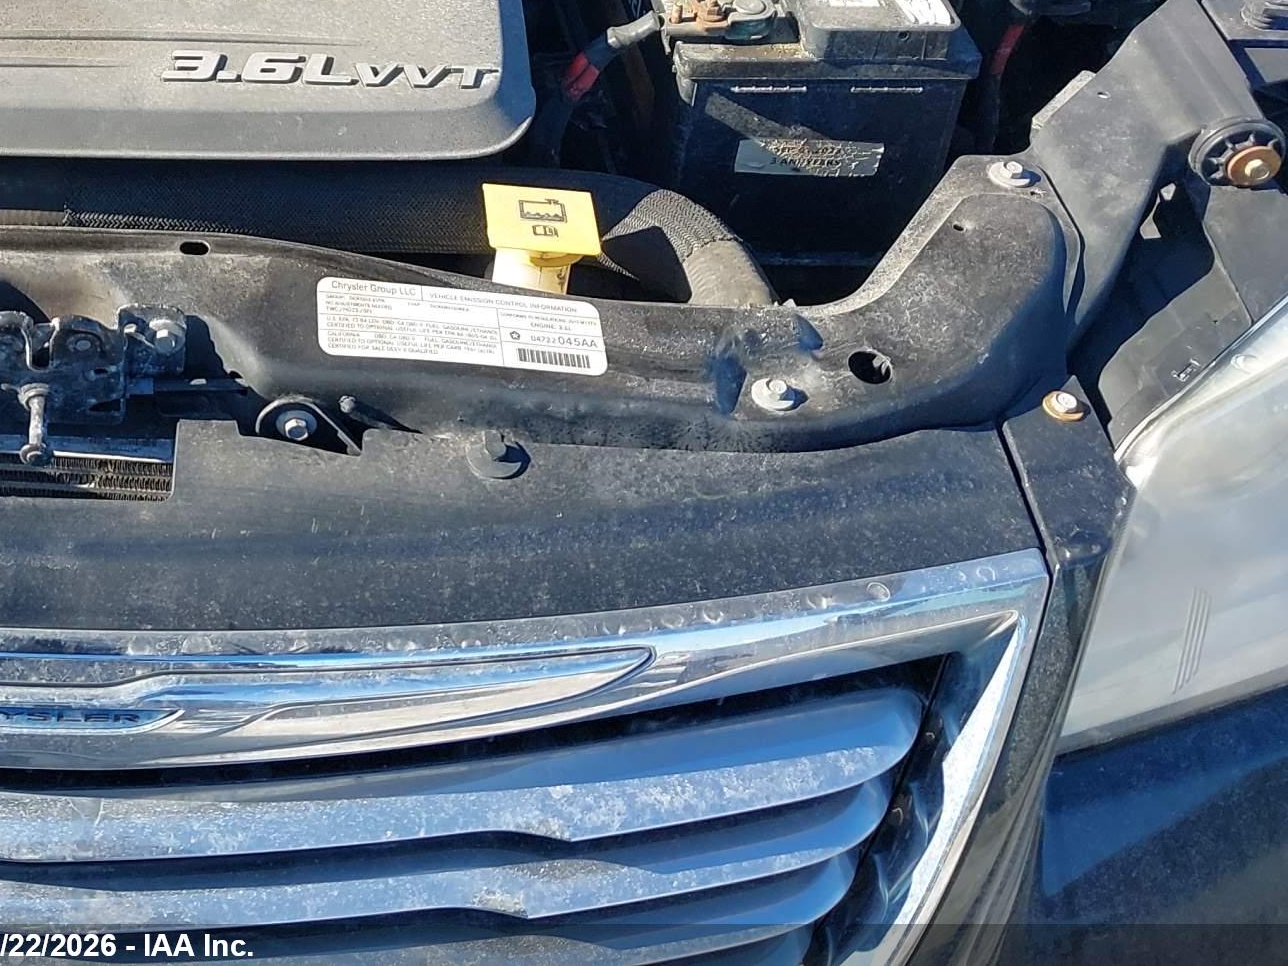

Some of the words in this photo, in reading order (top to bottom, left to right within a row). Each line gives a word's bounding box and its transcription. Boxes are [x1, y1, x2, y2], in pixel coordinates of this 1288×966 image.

[355, 62, 501, 90] VVT
[331, 280, 369, 292] Chrysler
[370, 283, 397, 295] Group
[399, 286, 417, 296] LLC
[429, 292, 458, 301] VEHICLE
[460, 295, 494, 305] EMISSION
[495, 299, 528, 308] CONTROL
[530, 302, 578, 313] INFORMATION
